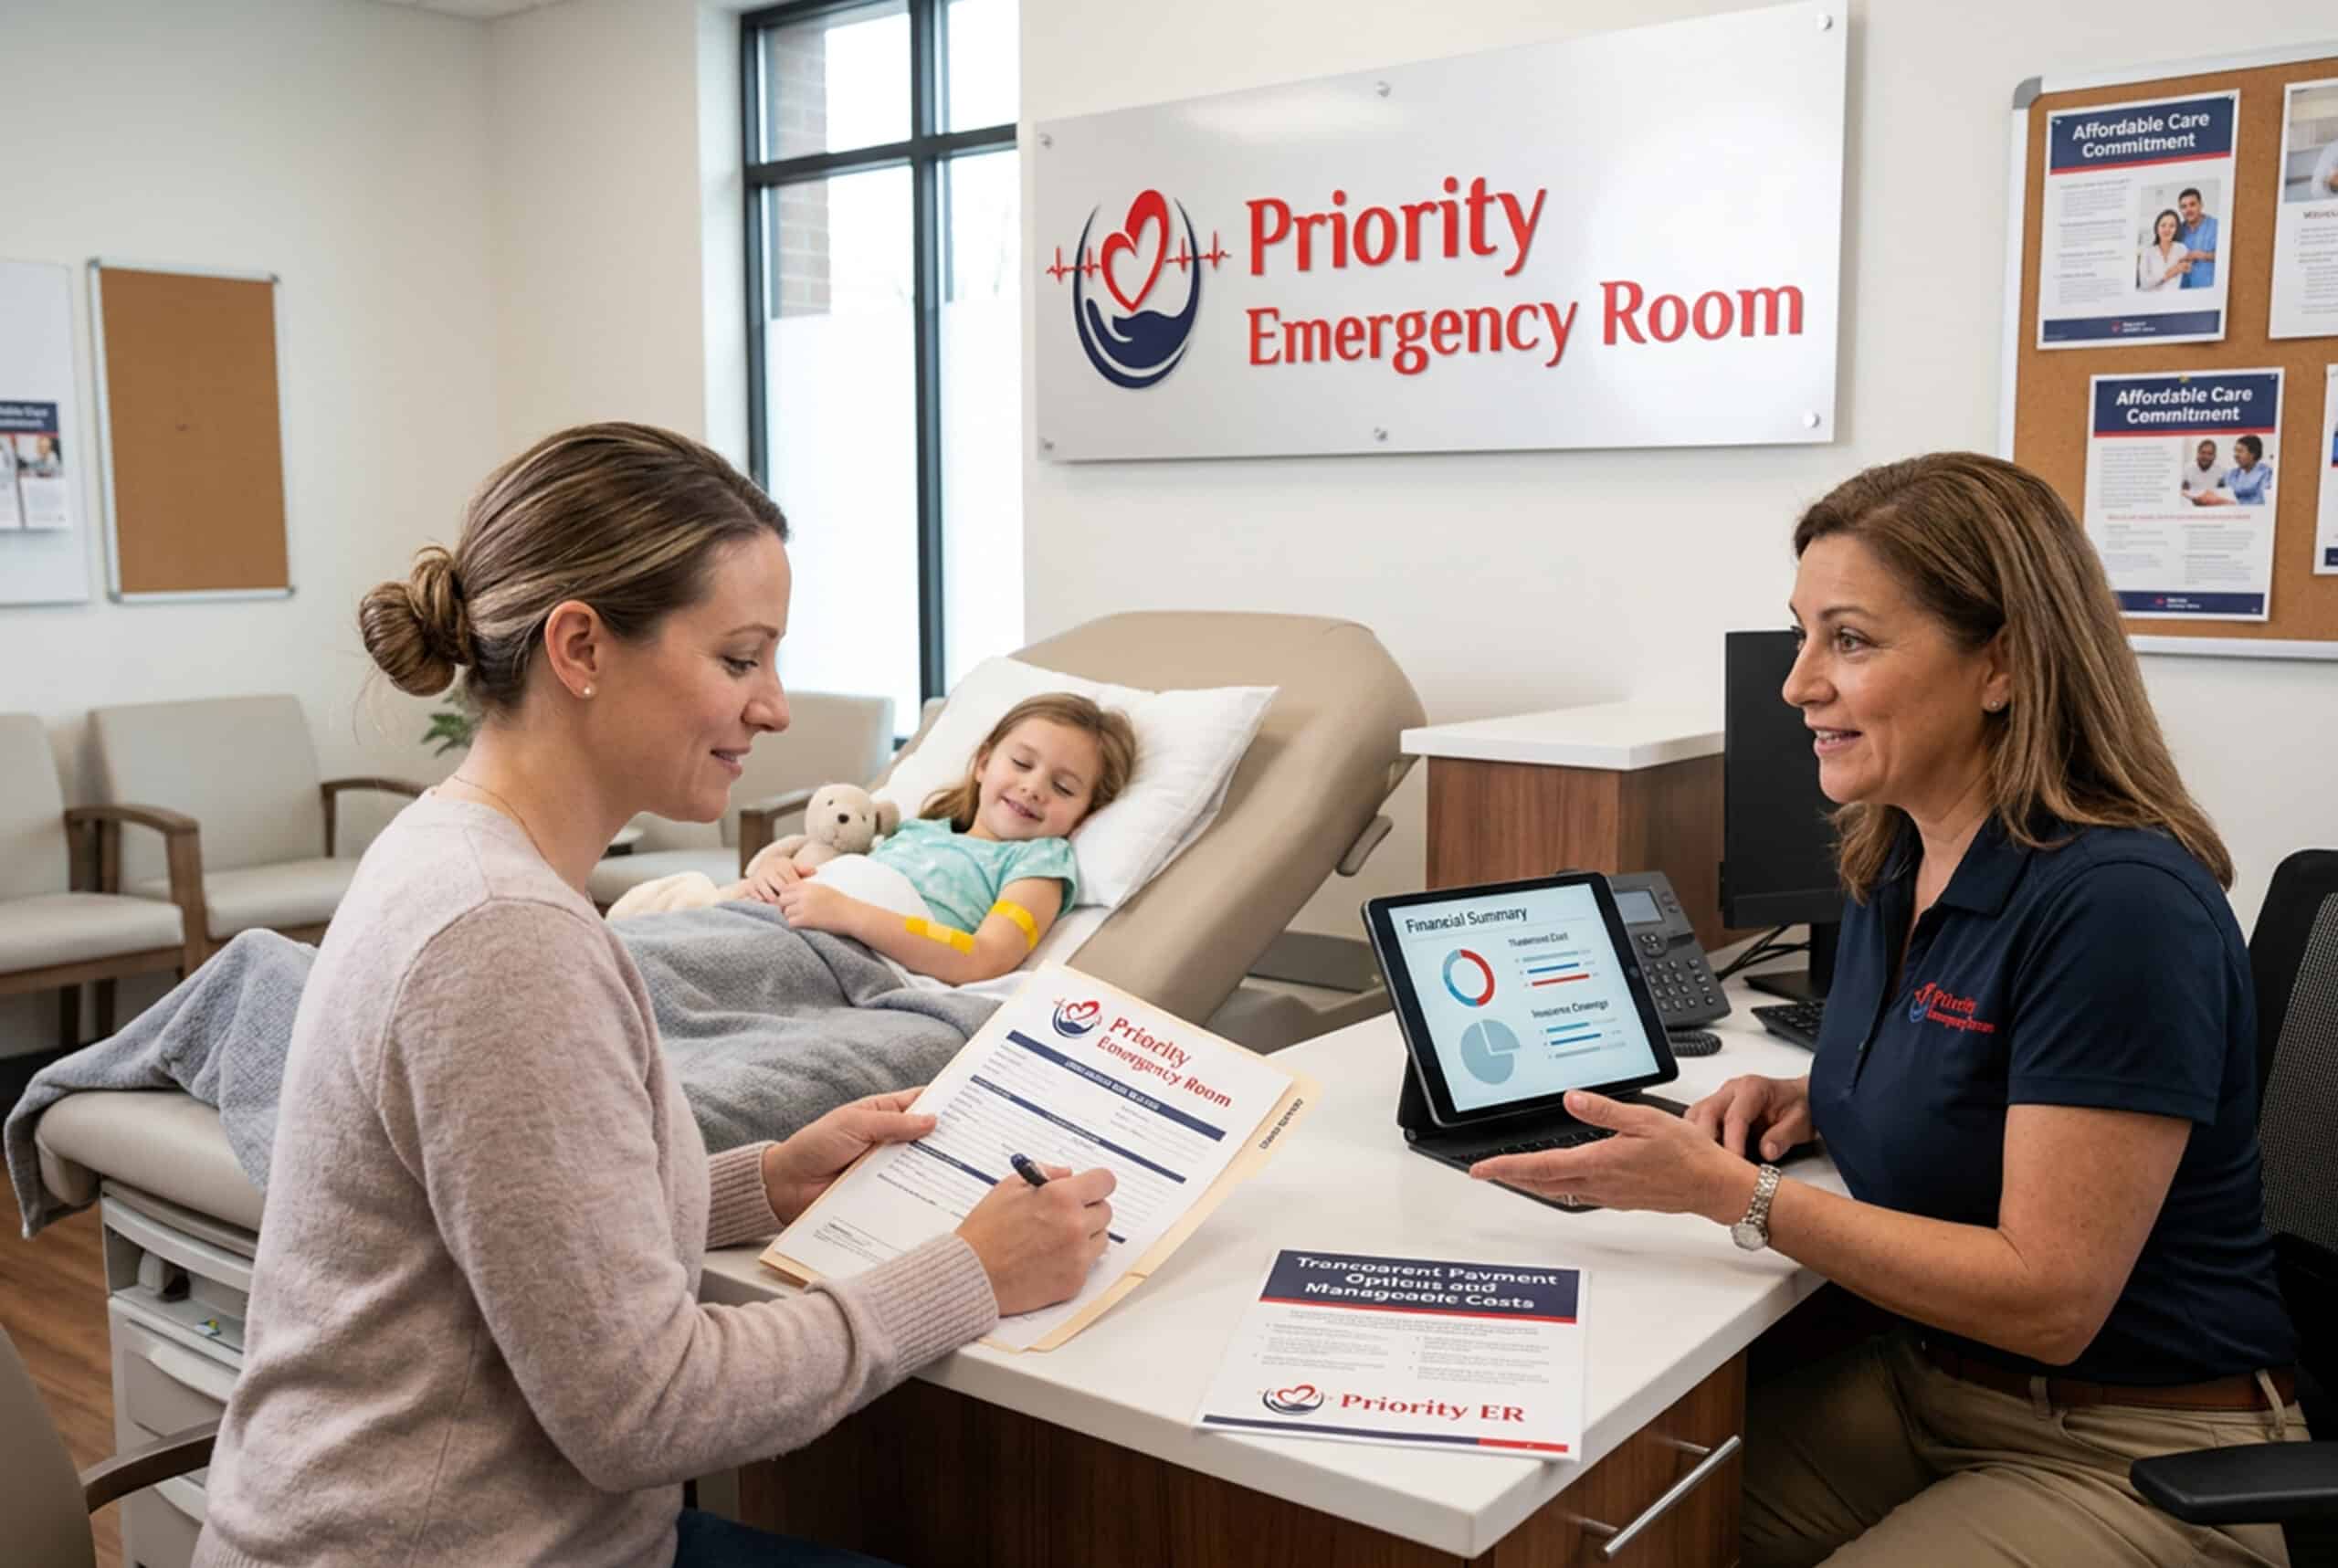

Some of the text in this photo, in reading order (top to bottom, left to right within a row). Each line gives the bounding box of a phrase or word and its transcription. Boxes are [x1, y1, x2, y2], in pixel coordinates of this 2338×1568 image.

[2072, 113, 2210, 141] Affordable Care
[2082, 133, 2196, 158] Commitment
[1246, 177, 1546, 277] Priority
[1246, 280, 1804, 375] Emergency Room
[2115, 386, 2253, 405] Affordable Care
[2126, 406, 2240, 424] Commitment
[1406, 905, 1528, 933] Financial Summary
[1465, 1294, 1535, 1310] Costs
[1341, 1392, 1525, 1423] Priority ER
